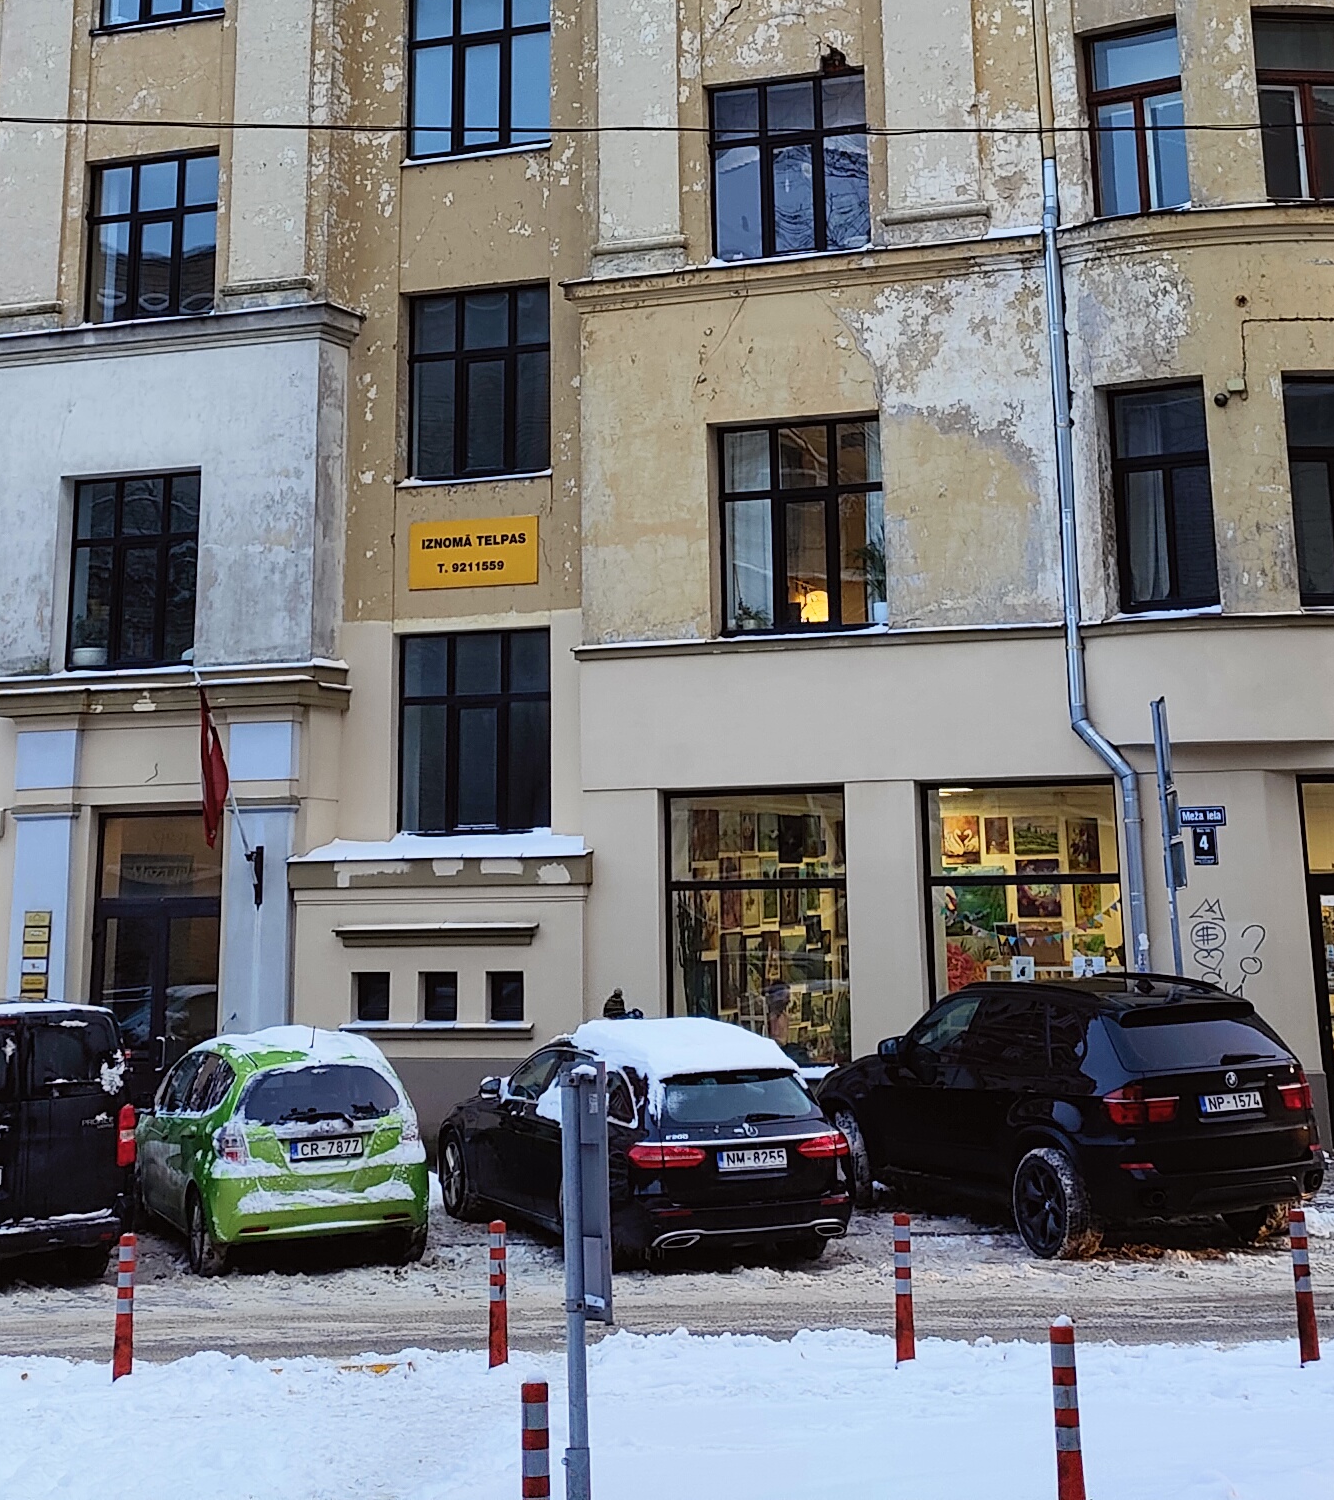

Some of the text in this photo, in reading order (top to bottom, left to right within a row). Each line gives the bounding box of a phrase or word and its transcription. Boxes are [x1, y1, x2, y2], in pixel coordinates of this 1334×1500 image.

[421, 532, 527, 550] IZNOMĀ TELPAS
[437, 560, 505, 574] T. 9211559
[1181, 810, 1204, 822] Meža
[1199, 835, 1209, 851] 4
[1207, 1093, 1261, 1111] NP-1574
[300, 1139, 360, 1156] CR-7877
[726, 1149, 785, 1167] NM-8255
